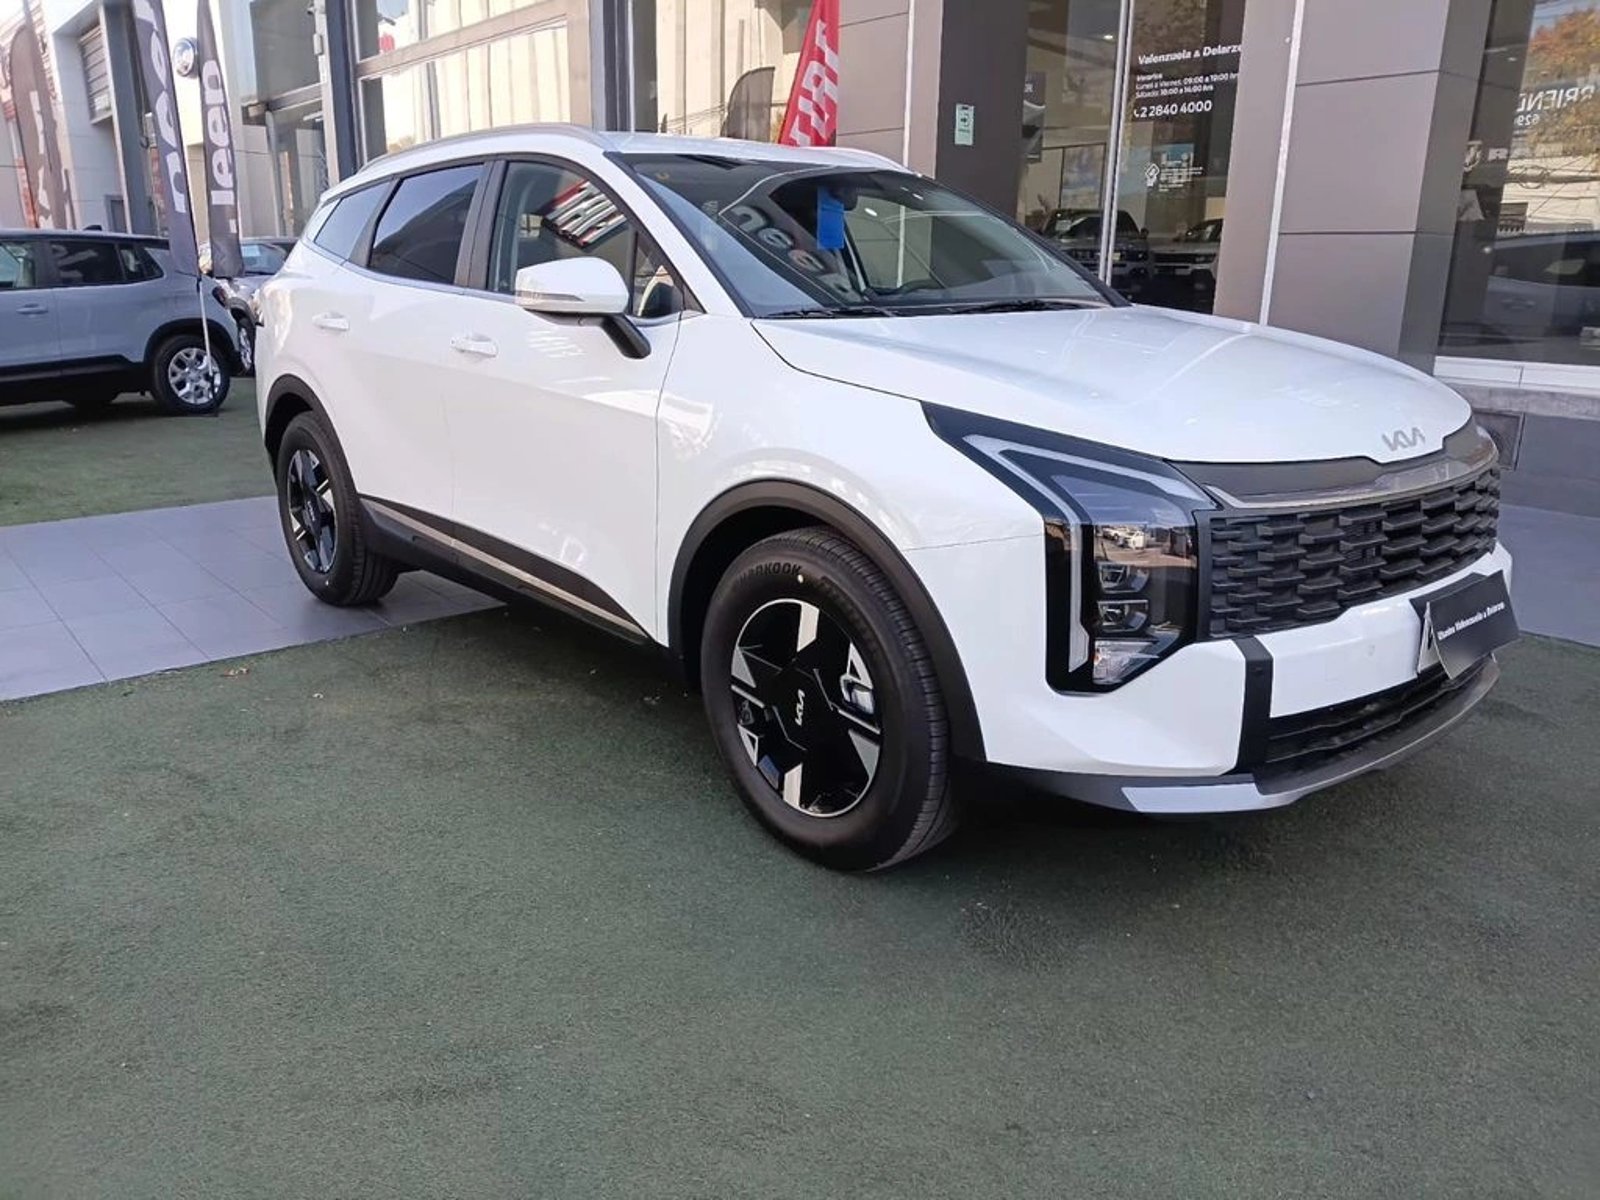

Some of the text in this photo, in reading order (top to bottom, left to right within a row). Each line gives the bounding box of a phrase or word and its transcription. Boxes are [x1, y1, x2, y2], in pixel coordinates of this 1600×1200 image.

[1140, 100, 1213, 118] 2 2840 4000
